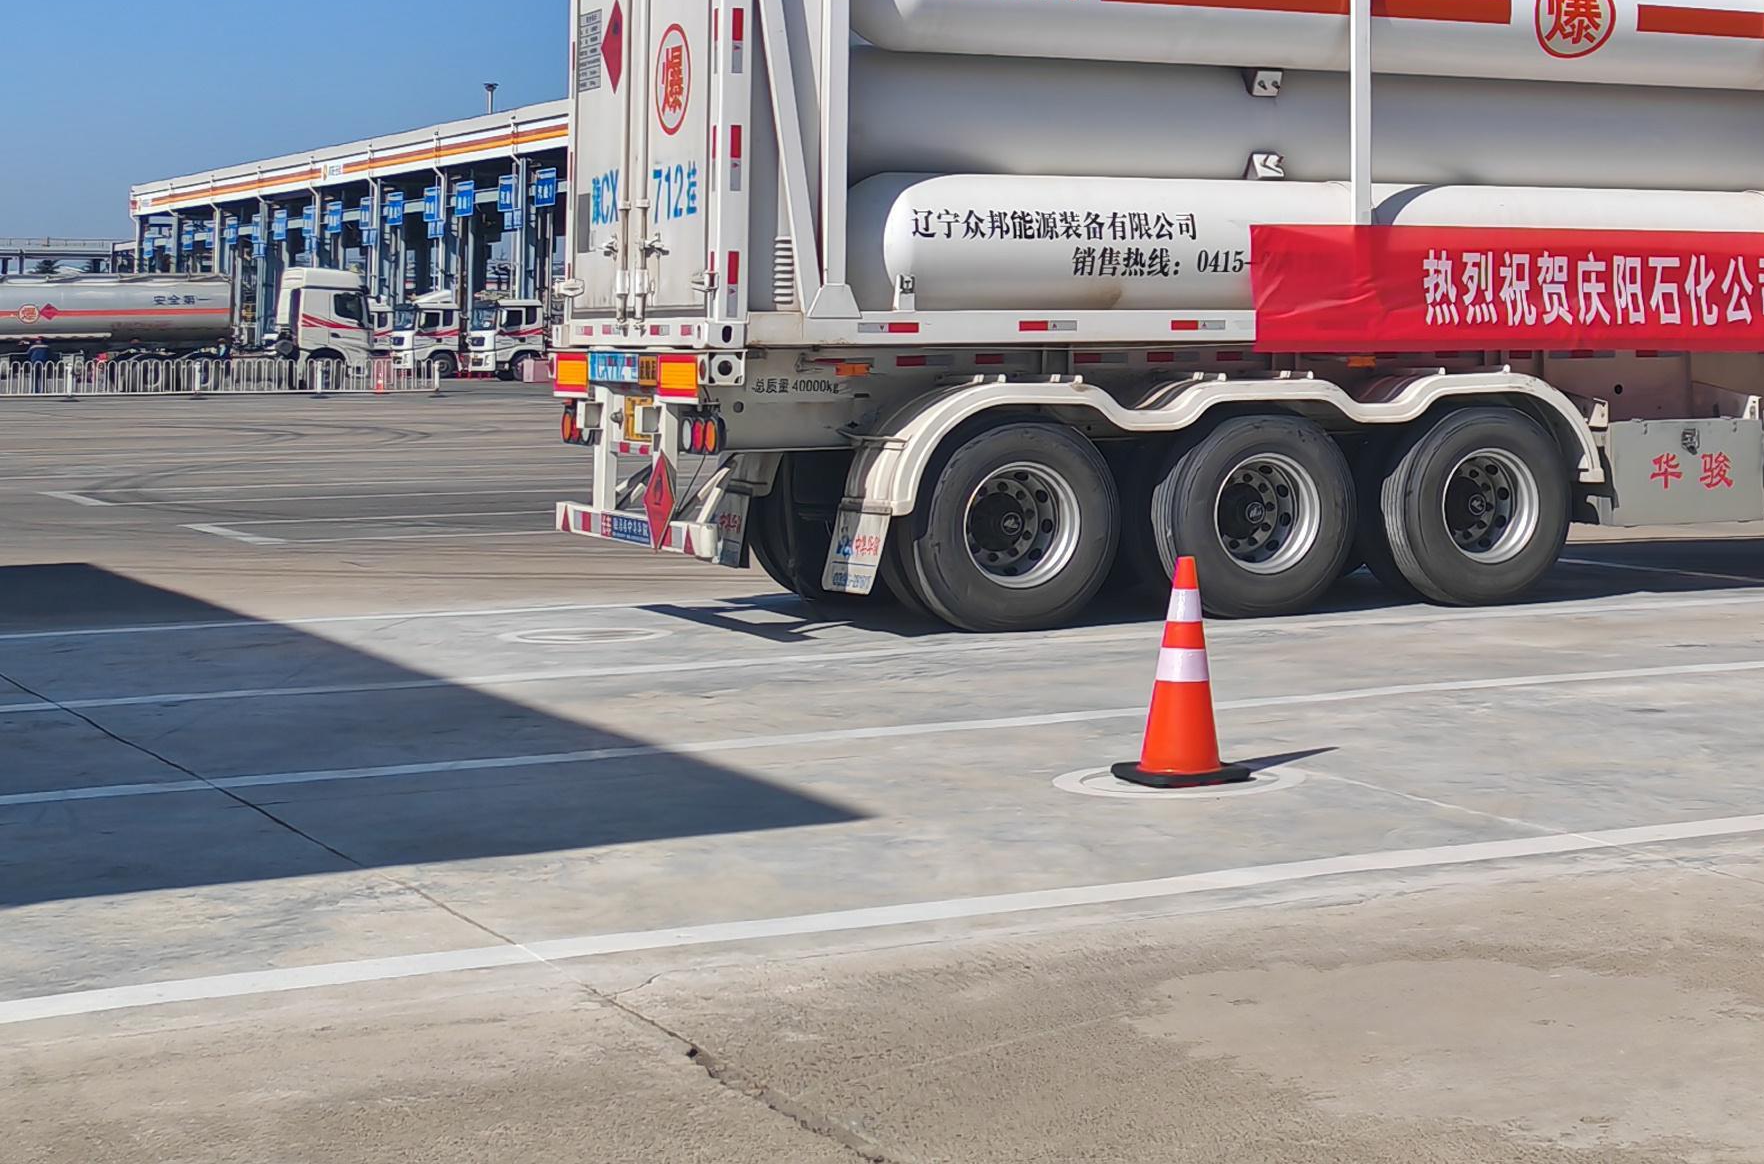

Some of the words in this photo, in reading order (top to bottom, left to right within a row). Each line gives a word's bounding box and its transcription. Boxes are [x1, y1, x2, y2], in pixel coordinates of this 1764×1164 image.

[911, 208, 1198, 241] 辽宁众邦能源装备有限公司
[153, 295, 211, 306] 安全第一
[1650, 452, 1734, 490] 华骏
